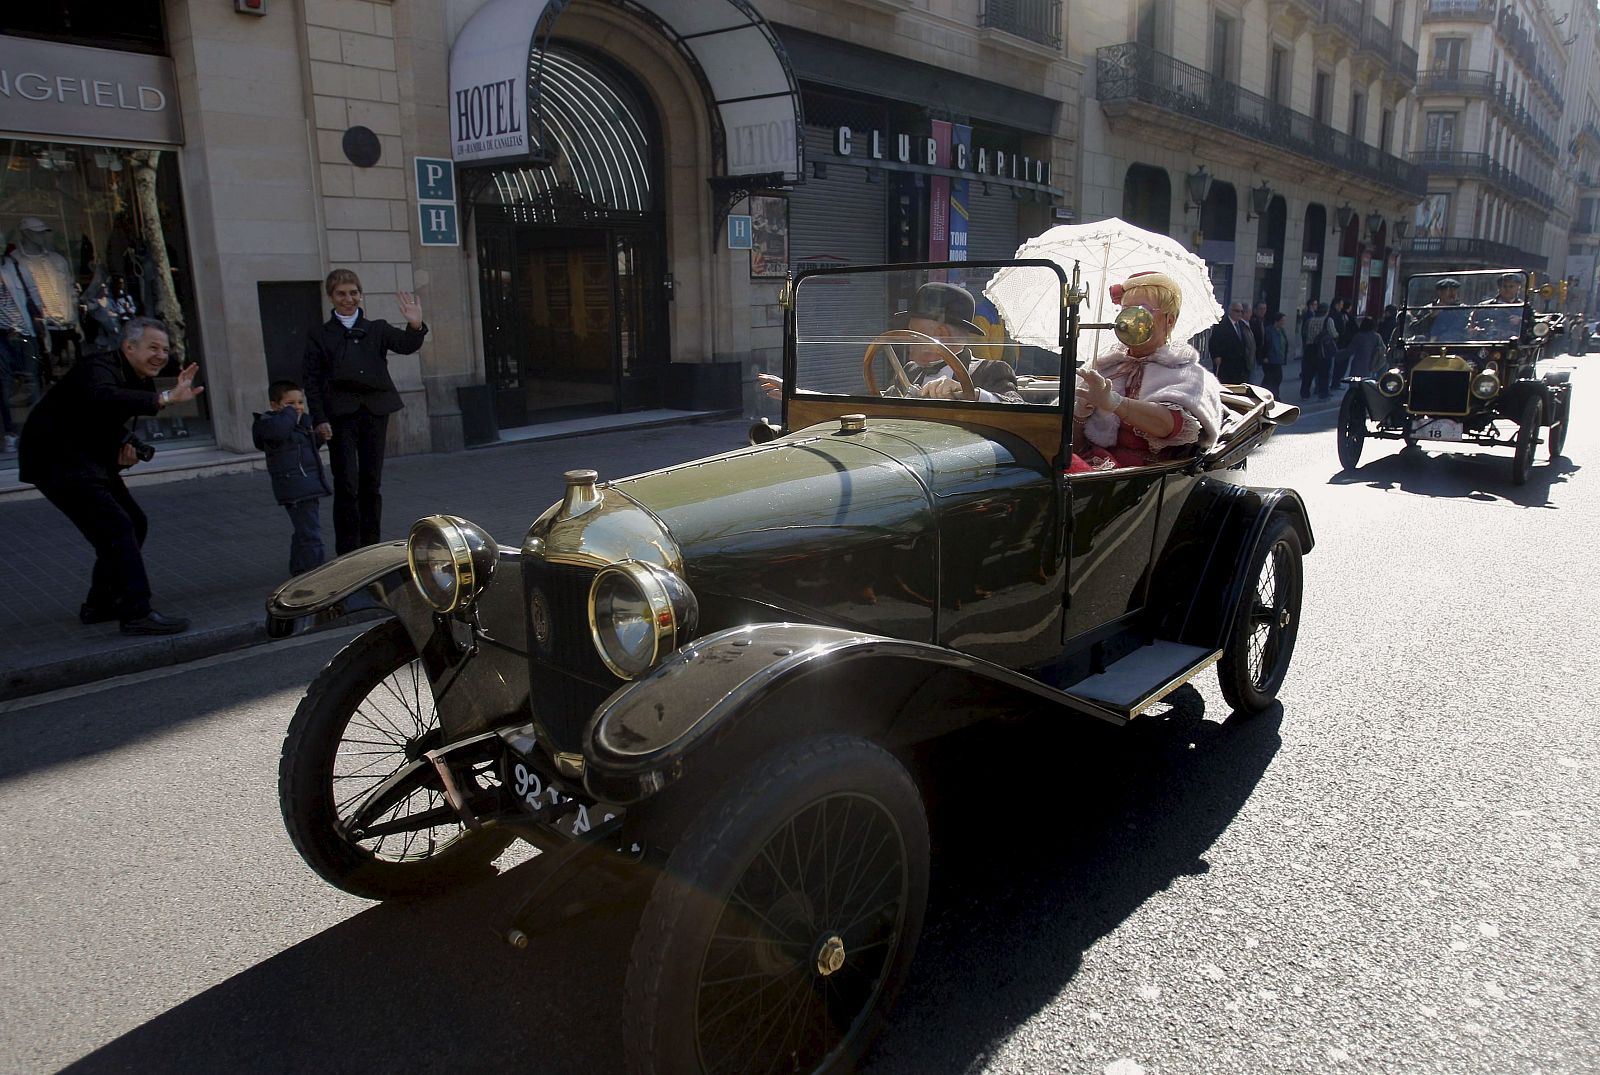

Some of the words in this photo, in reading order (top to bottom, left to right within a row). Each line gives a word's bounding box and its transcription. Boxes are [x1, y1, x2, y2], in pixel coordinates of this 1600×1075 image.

[456, 78, 520, 141] HOTEL
[838, 126, 937, 165] CLUB
[426, 164, 443, 187] P
[429, 209, 448, 232] H
[735, 220, 745, 237] H
[950, 231, 968, 246] TONI
[1429, 430, 1442, 438] 18
